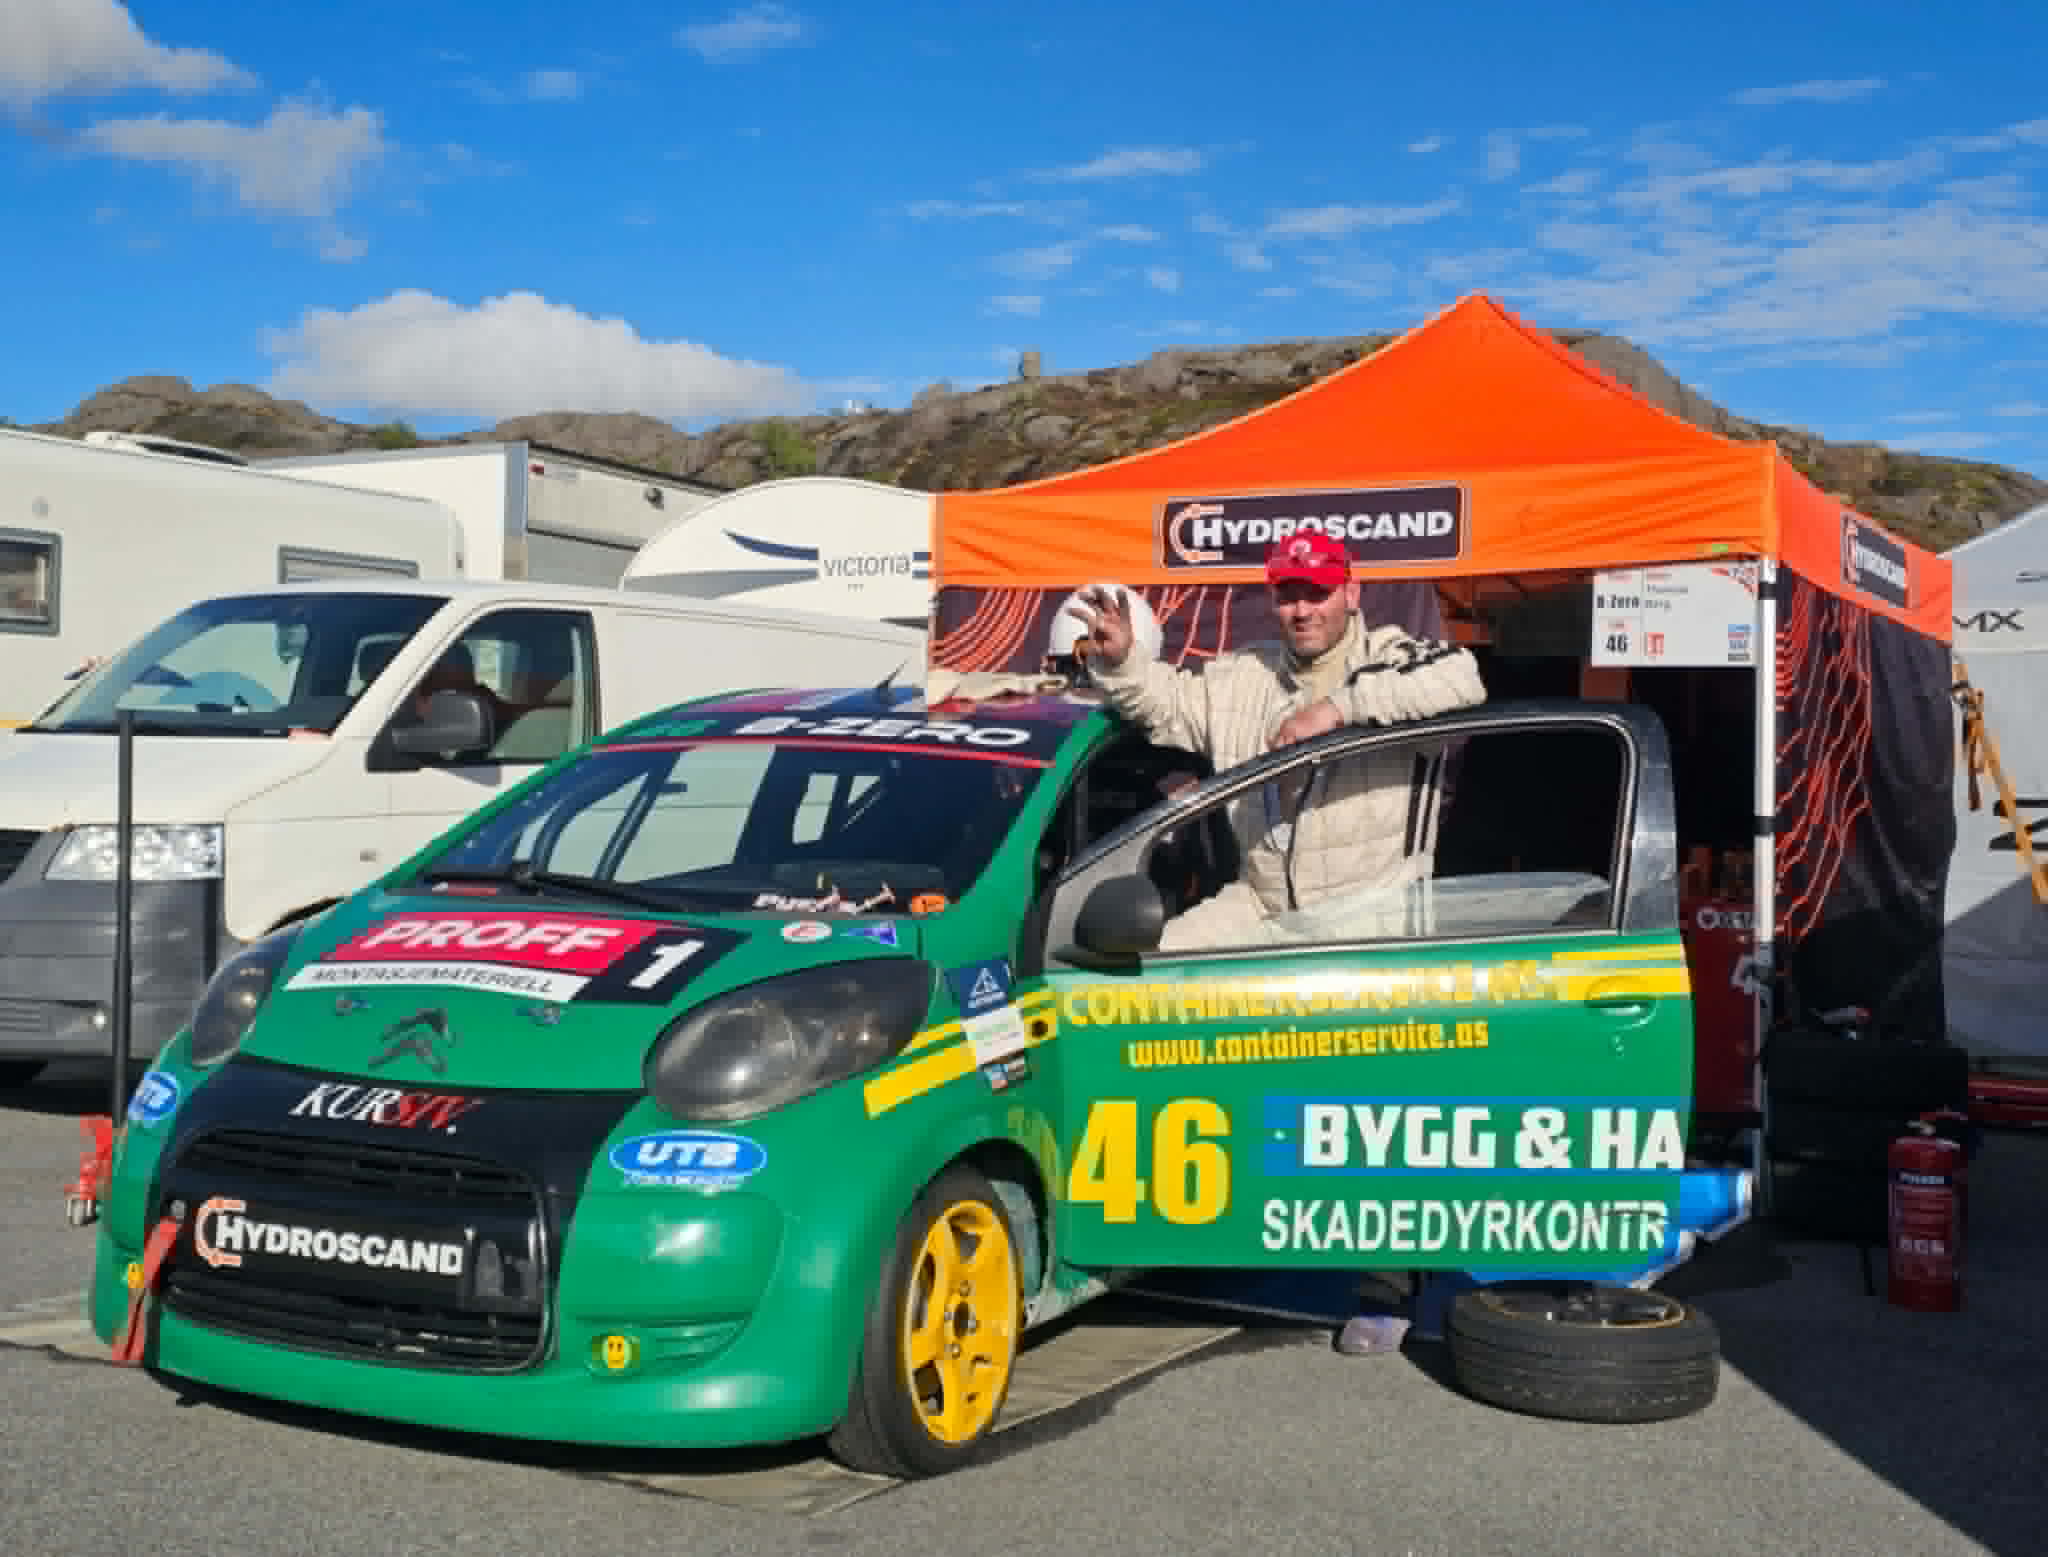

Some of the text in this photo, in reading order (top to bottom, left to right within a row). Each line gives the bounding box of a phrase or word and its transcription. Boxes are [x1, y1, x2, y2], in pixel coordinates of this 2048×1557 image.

[824, 555, 911, 577] victoria
[1606, 634, 1629, 653] 46
[359, 919, 625, 957] PROFF
[628, 940, 704, 989] 1
[638, 1142, 738, 1168] UTB
[1303, 1103, 1686, 1171] BYGG & HA
[1068, 1098, 1231, 1227] 46
[215, 1214, 465, 1276] HYDROSCAND
[1261, 1199, 1669, 1253] SKADEDYRKONTR
